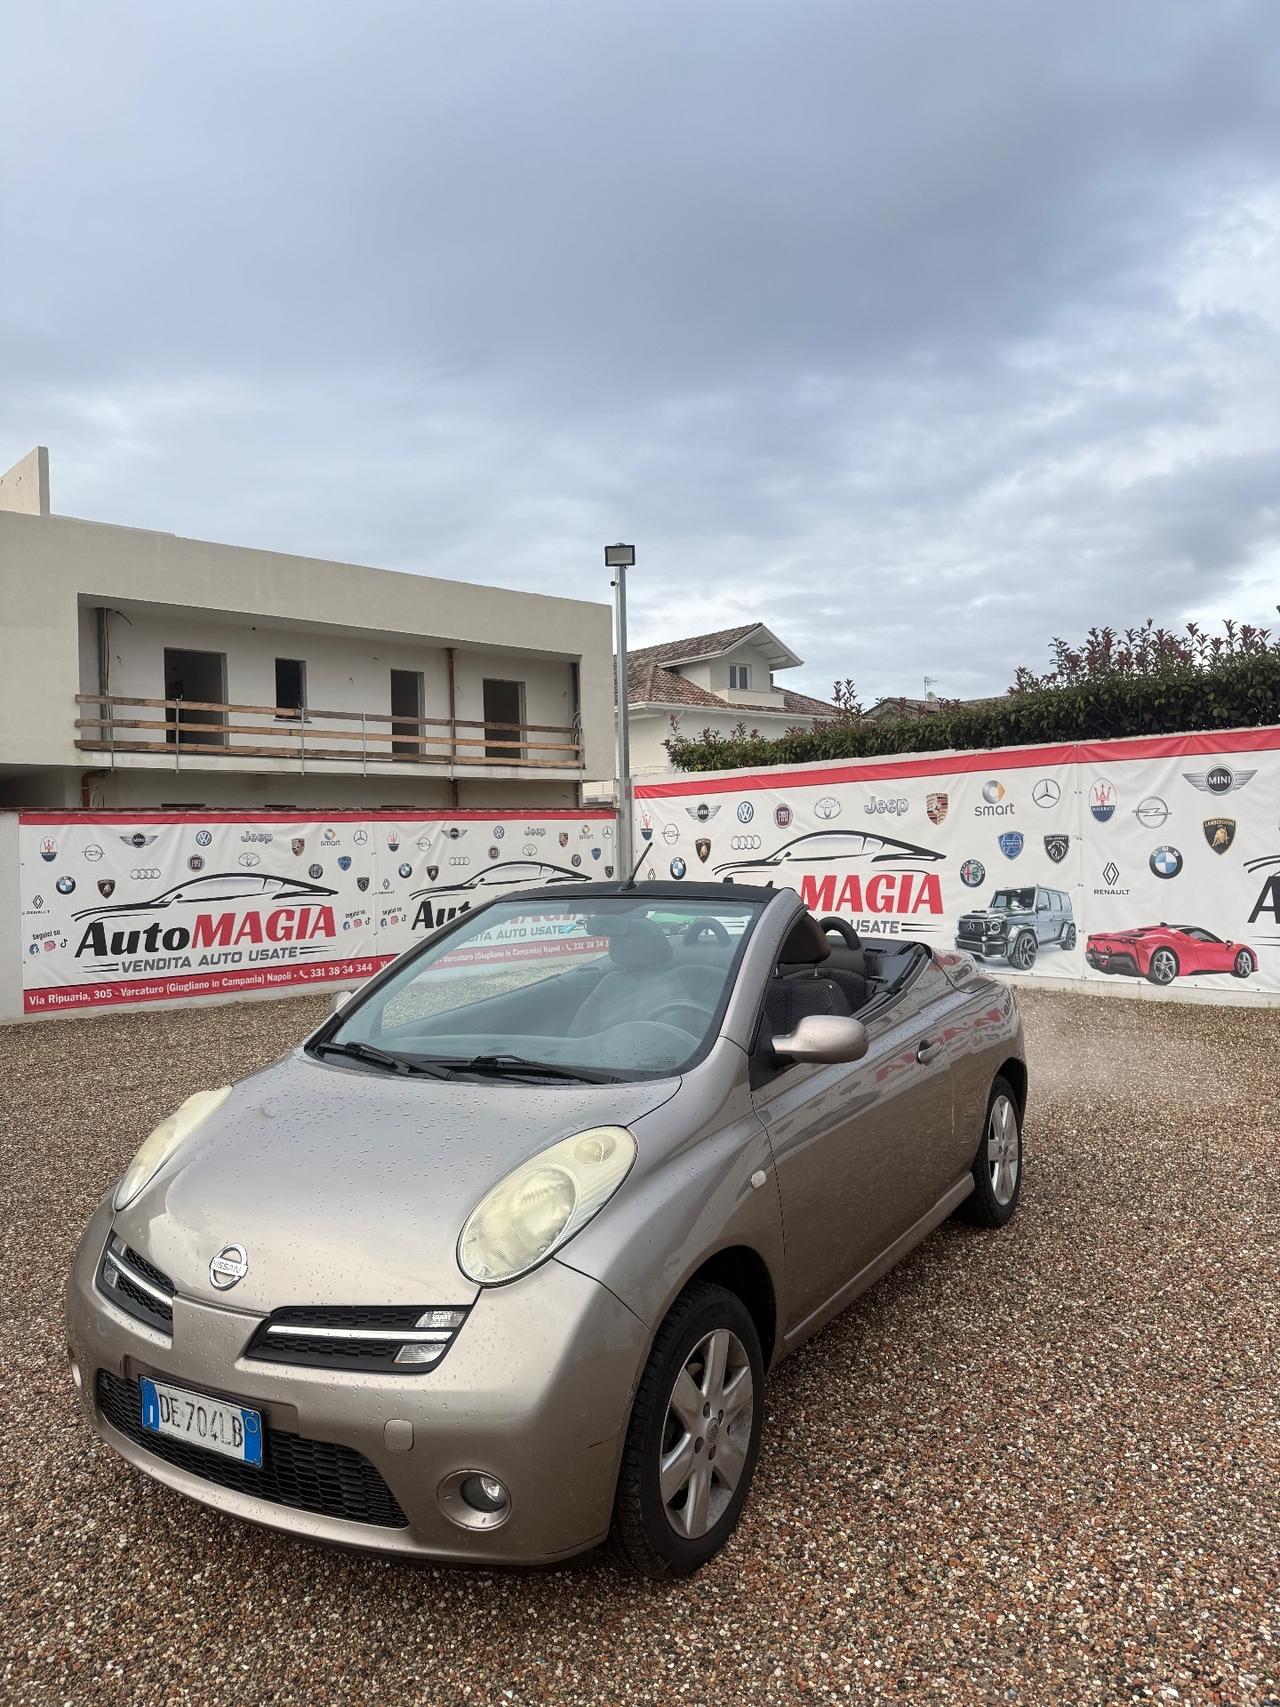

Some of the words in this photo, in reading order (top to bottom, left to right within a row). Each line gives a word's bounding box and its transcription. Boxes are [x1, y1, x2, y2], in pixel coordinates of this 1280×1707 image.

[1208, 776, 1231, 785] MINI
[864, 796, 909, 816] Jeep
[974, 802, 1015, 816] smart
[776, 810, 789, 822] FIAT
[240, 831, 273, 844] Jeep
[525, 826, 547, 837] Jeep
[320, 839, 341, 847] smart
[850, 919, 900, 934] USATE
[496, 928, 527, 939] AUTO
[121, 956, 192, 973] VENDITA
[198, 952, 242, 967] AUTO
[249, 946, 299, 962] USATE
[29, 996, 45, 1006] Via
[48, 991, 91, 1005] Ripuaria,
[94, 989, 113, 1000] 305
[120, 985, 164, 997] Varcaturo
[166, 980, 209, 995] (Giugliano
[211, 979, 220, 989] in
[222, 971, 265, 987] Campania)
[267, 971, 292, 983] Napoli
[310, 967, 325, 978] 331
[328, 966, 340, 976] 38
[342, 964, 354, 974] 34
[356, 963, 372, 973] 344
[213, 1258, 243, 1276] NISSAN
